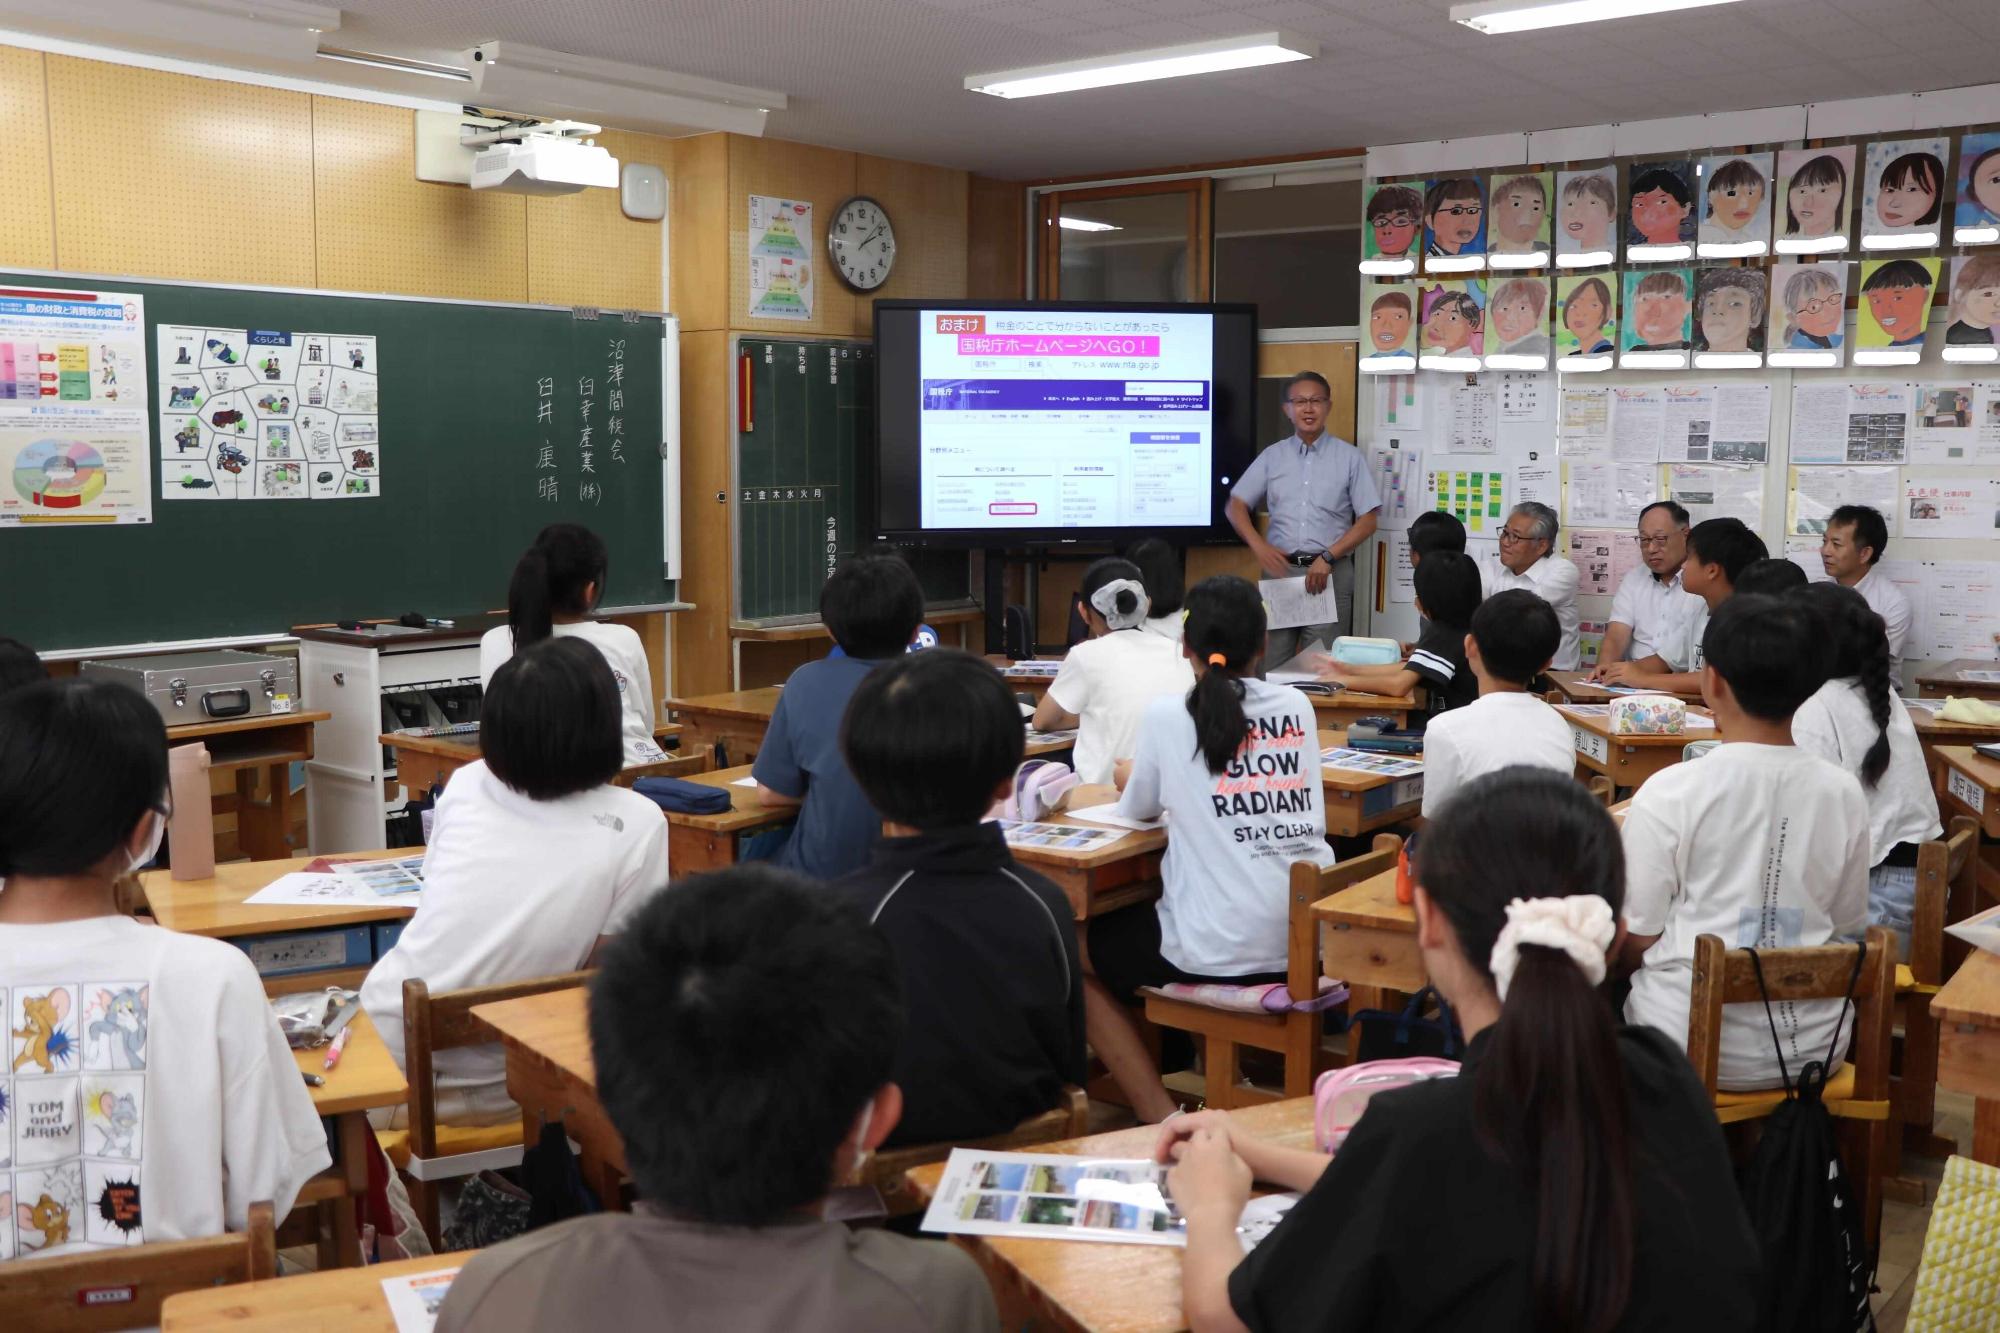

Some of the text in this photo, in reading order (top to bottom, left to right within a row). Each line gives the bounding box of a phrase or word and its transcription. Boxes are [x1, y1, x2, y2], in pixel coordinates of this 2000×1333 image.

[847, 212, 854, 222] 11
[858, 208, 866, 219] 12
[871, 215, 875, 224] 1
[839, 224, 847, 234] 10
[878, 226, 884, 236] 2
[881, 242, 887, 252] 3
[841, 256, 846, 265] 8
[878, 259, 884, 267] 4
[849, 267, 855, 277] 7
[859, 271, 865, 281] 6
[870, 268, 876, 278] 5
[940, 318, 979, 332] おまけ
[996, 320, 1170, 334] 税金のことで分からないことがあったら
[841, 350, 848, 358] 6
[856, 350, 862, 359] 5
[798, 346, 806, 374] 持ち物
[1100, 360, 1160, 371] www.nta.go.jp
[537, 377, 553, 424] 臼井
[607, 339, 626, 464] 沼津間税会
[744, 490, 752, 500] 土
[758, 490, 766, 500] 金
[772, 490, 781, 499] 木
[786, 489, 794, 499] 水
[800, 489, 808, 498] 火
[814, 488, 822, 498] 月
[826, 516, 837, 580] 今週の予定
[1244, 714, 1305, 740] RNAL
[1227, 751, 1299, 779] GLOW
[1212, 787, 1312, 818] RADIANT
[1233, 823, 1314, 843] STAY CLEAR
[27, 1101, 64, 1115] TOM
[30, 1111, 63, 1125] and
[22, 1124, 73, 1139] JERRY
